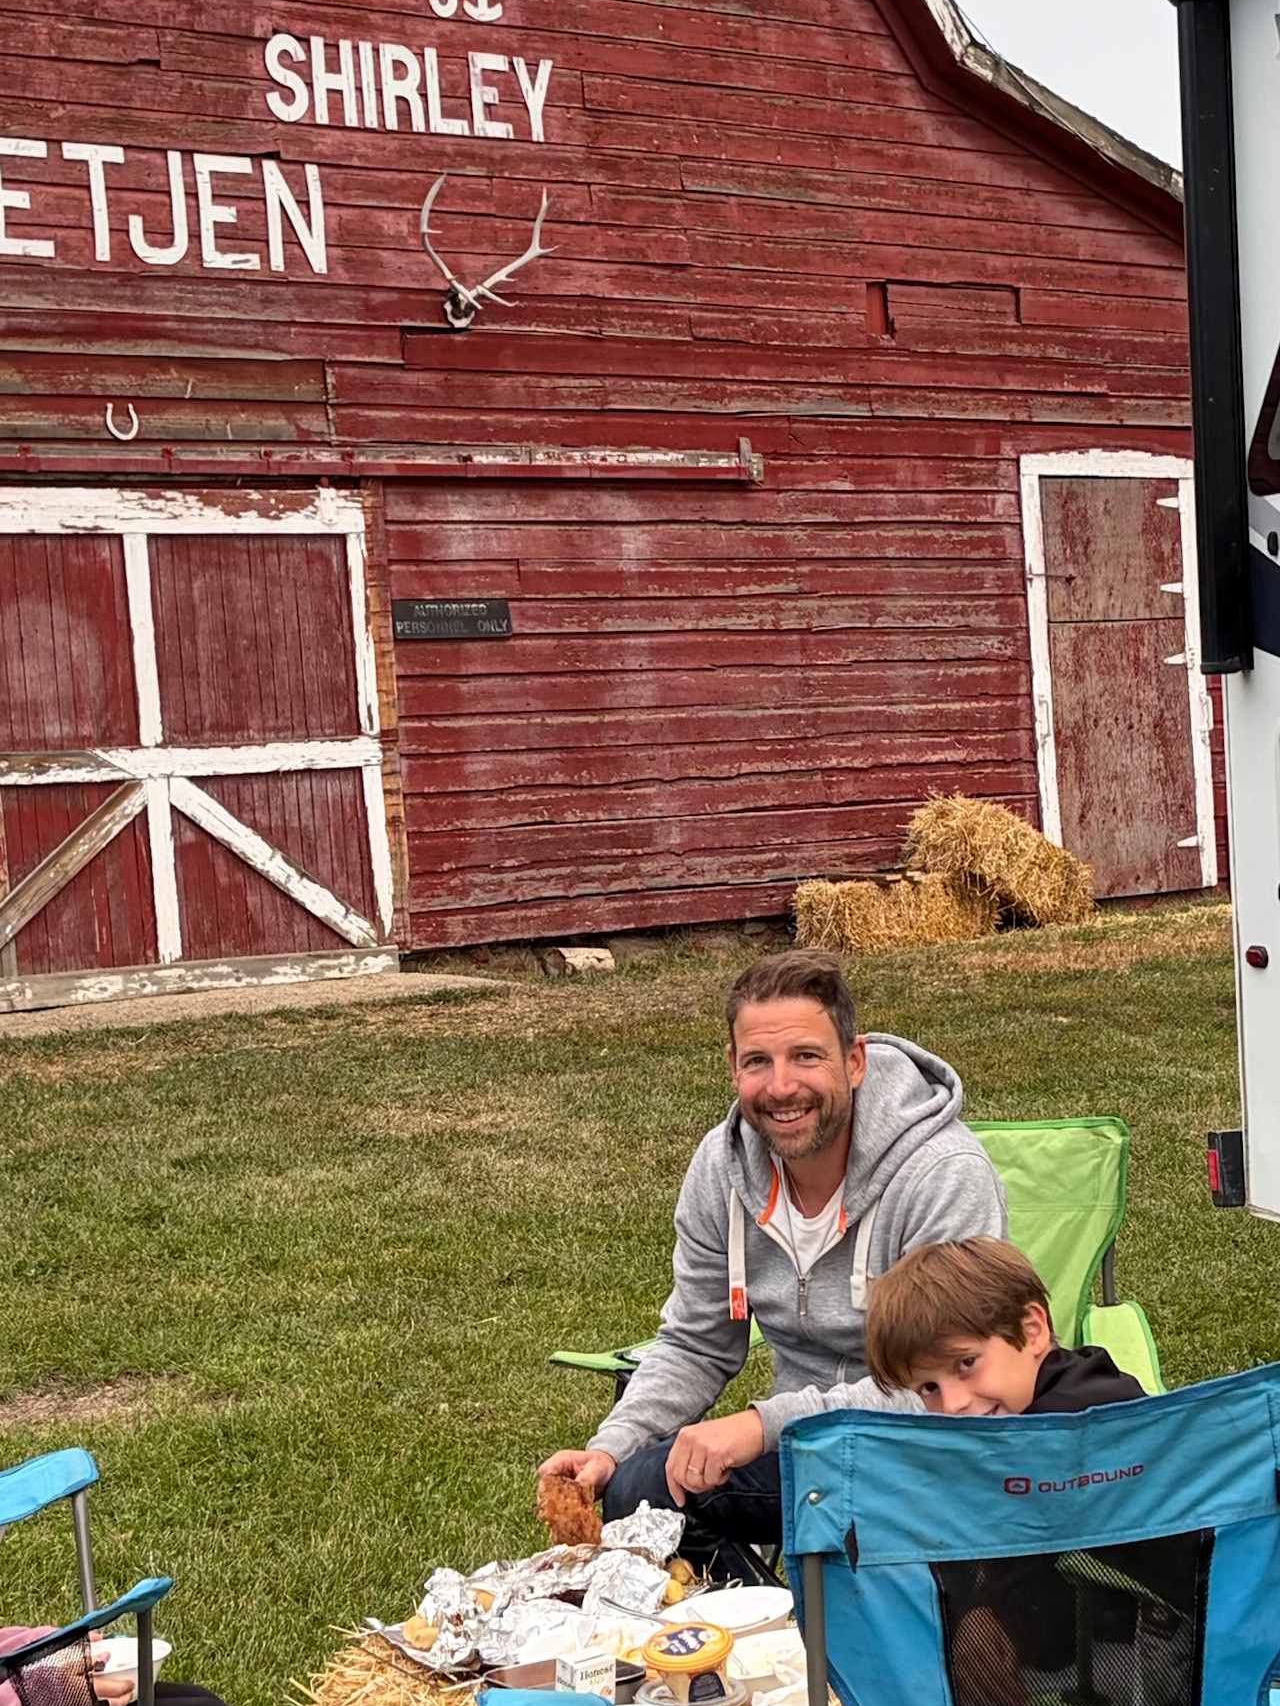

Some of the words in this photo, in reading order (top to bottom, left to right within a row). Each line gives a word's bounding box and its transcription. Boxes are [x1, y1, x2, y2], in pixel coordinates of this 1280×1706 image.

[264, 33, 553, 143] SHIRLEY
[414, 603, 488, 617] AUTHORIZED
[476, 618, 508, 632] ONLY
[1037, 1464, 1144, 1493] OUTBOUND
